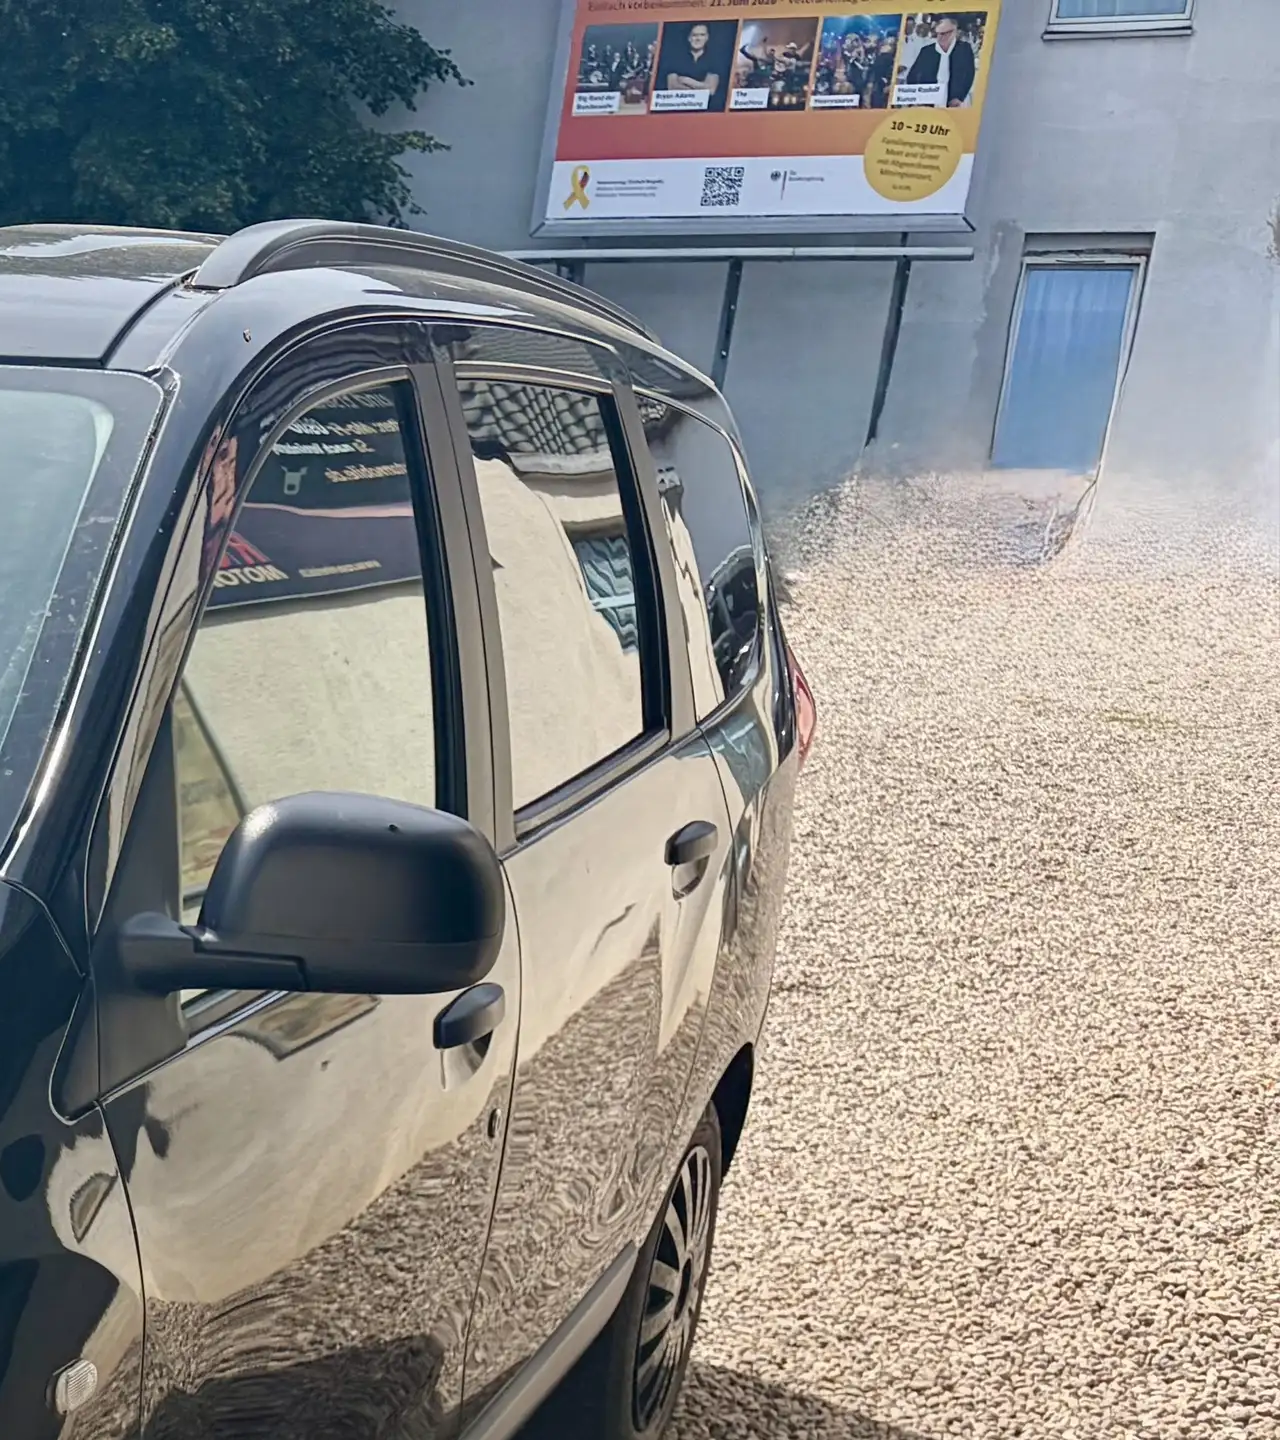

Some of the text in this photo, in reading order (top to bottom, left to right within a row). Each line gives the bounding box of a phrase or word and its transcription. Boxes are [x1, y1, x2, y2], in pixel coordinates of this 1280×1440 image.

[891, 121, 904, 131] 10
[914, 123, 928, 134] 19
[929, 124, 951, 136] Uhr
